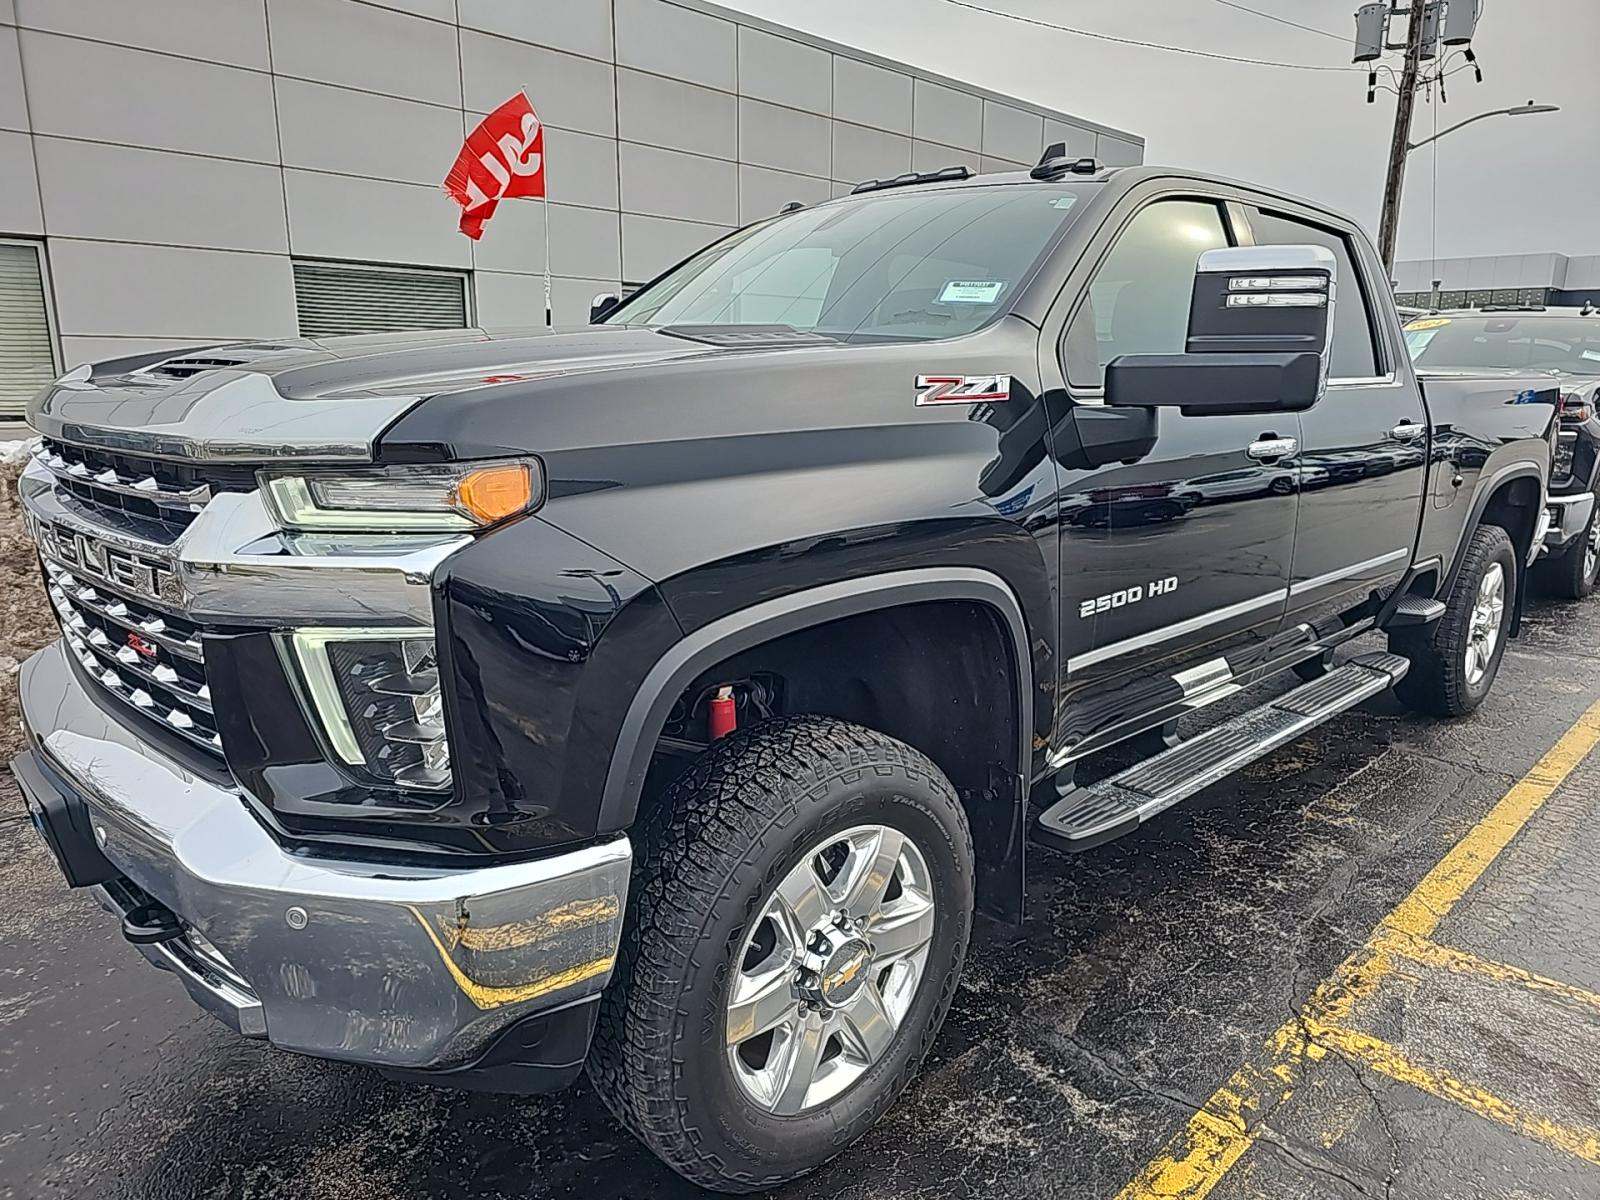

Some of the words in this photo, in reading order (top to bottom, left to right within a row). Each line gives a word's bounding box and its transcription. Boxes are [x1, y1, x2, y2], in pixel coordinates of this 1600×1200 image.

[915, 374, 1012, 406] Z71
[1079, 585, 1143, 619] 2500
[1147, 576, 1179, 598] HD
[700, 792, 867, 1046] WRANGLER
[830, 907, 967, 1147] GOODYEAR
